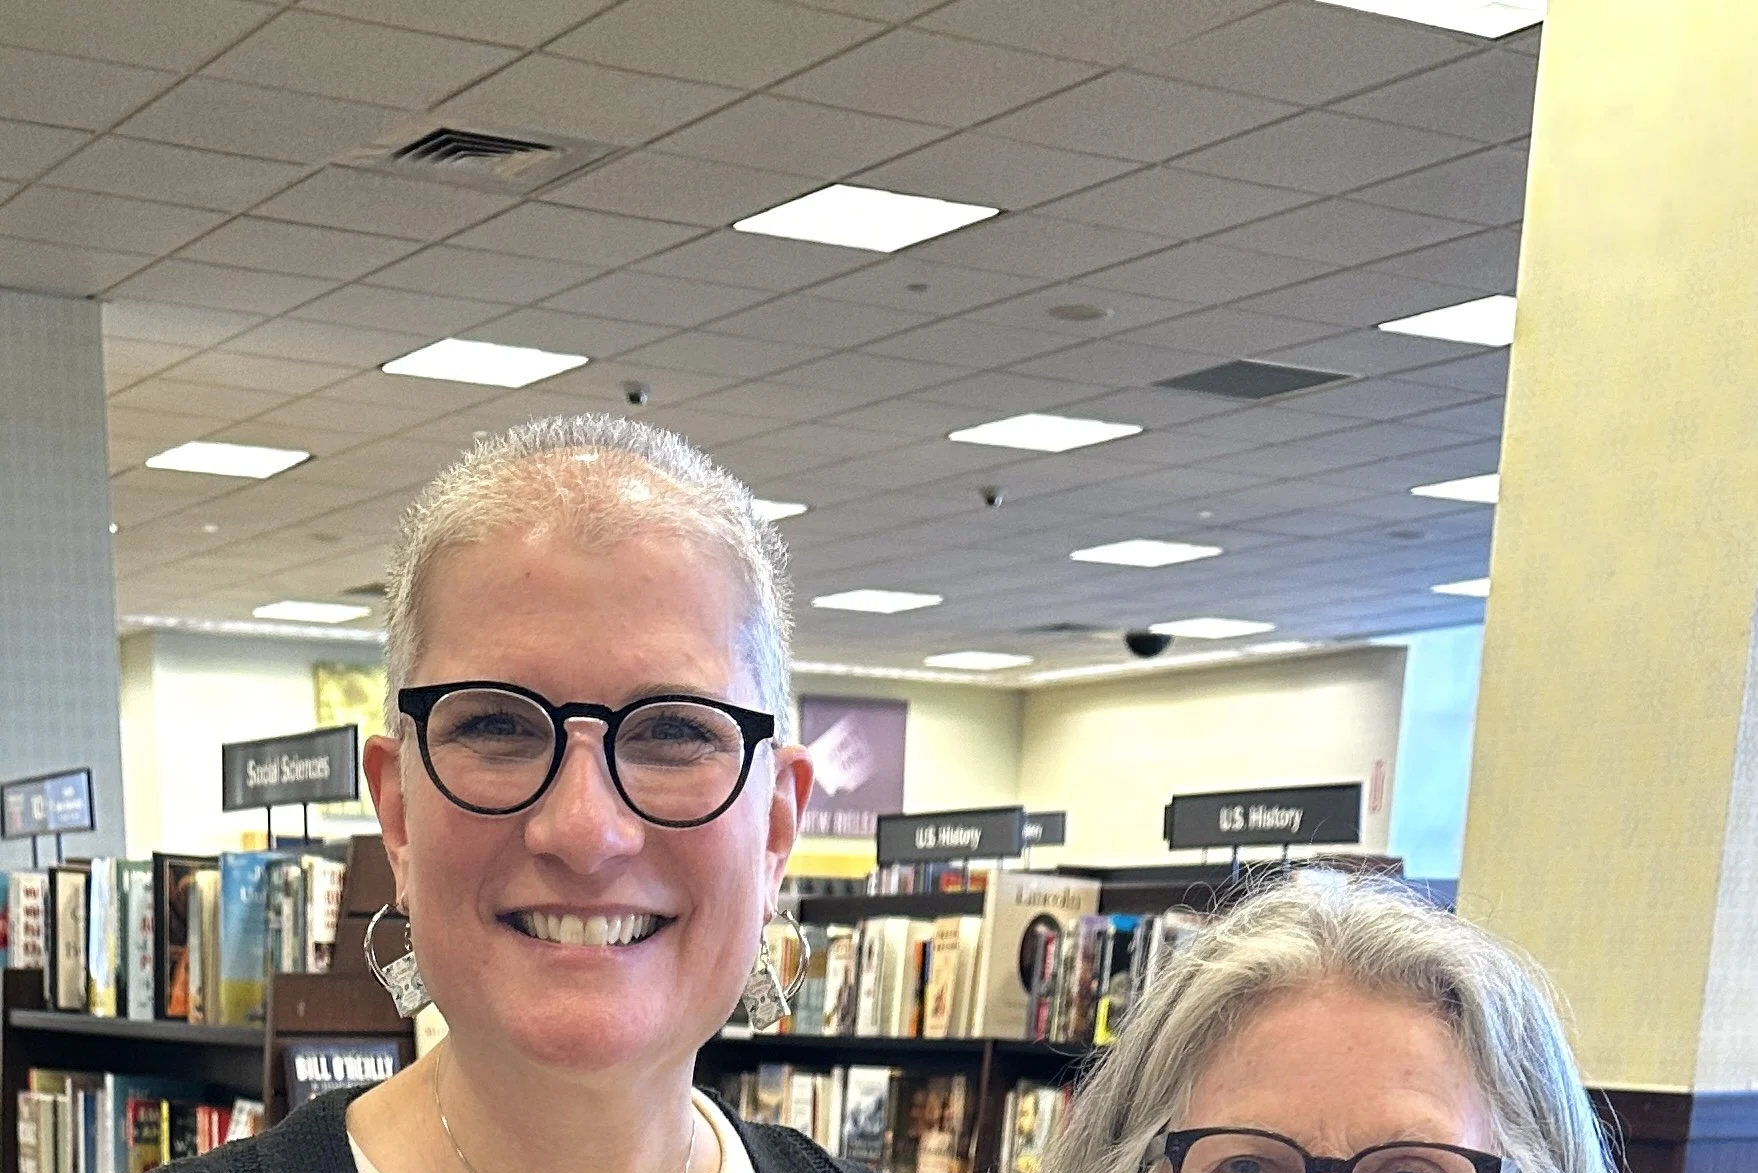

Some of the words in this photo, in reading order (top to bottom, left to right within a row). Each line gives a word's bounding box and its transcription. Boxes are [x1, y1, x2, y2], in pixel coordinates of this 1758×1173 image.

[246, 756, 280, 788] Social
[281, 753, 331, 784] Sciences
[1248, 803, 1304, 834] History
[937, 823, 983, 851] History
[295, 1054, 332, 1081] BILL
